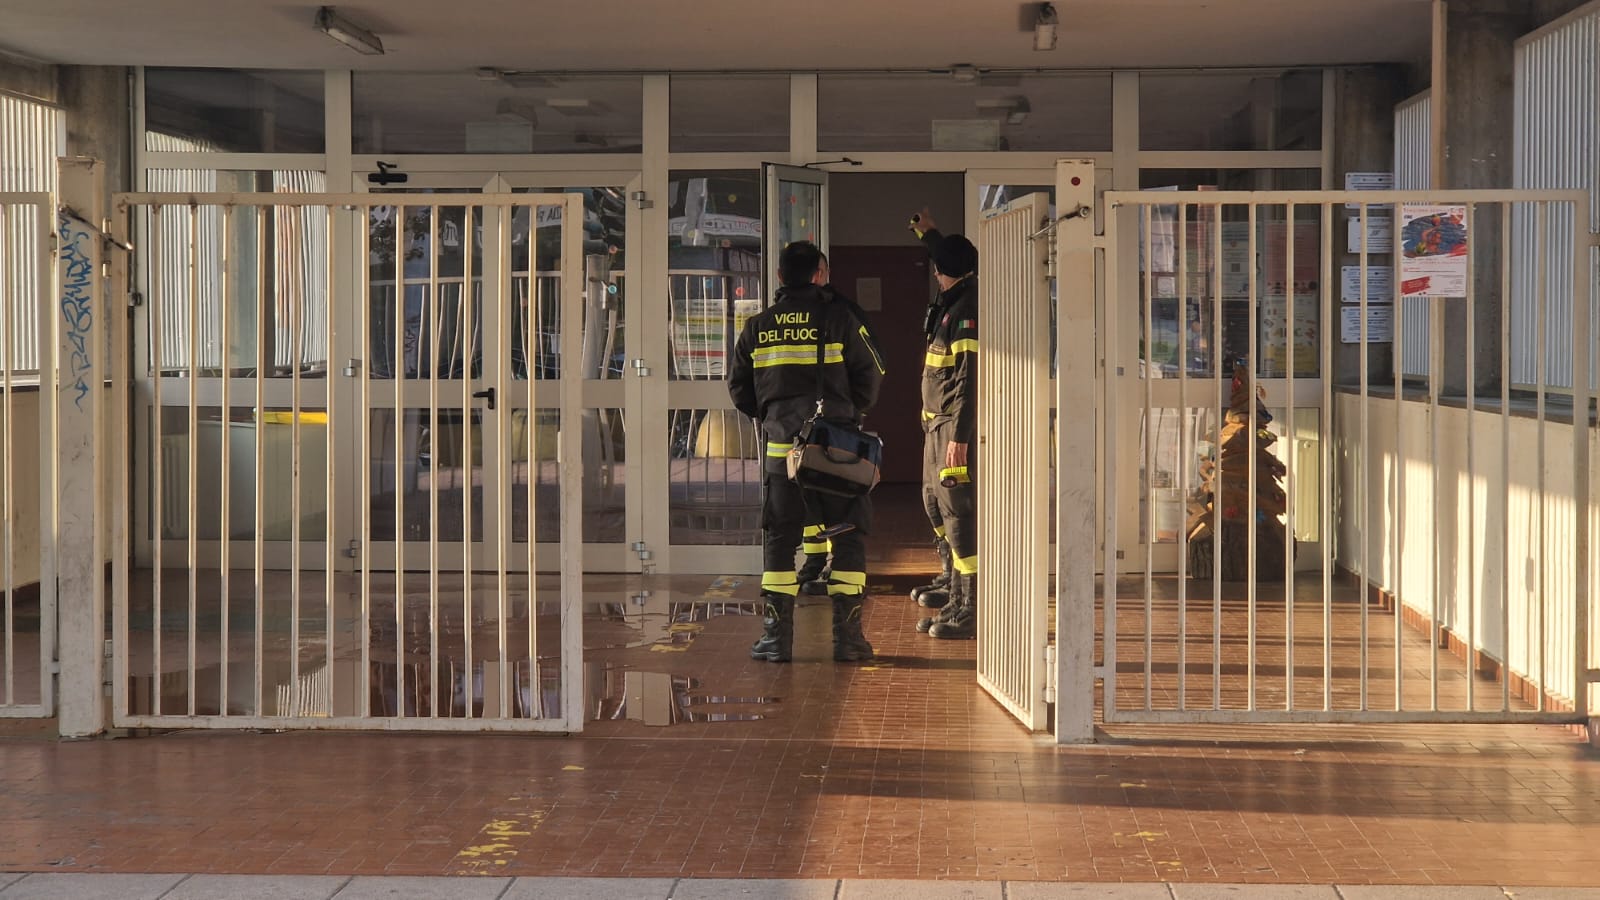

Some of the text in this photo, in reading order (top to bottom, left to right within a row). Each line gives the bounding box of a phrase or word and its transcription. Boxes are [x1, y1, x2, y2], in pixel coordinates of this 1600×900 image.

[774, 312, 810, 325] VIGILI
[758, 328, 820, 344] DEL FUOC
